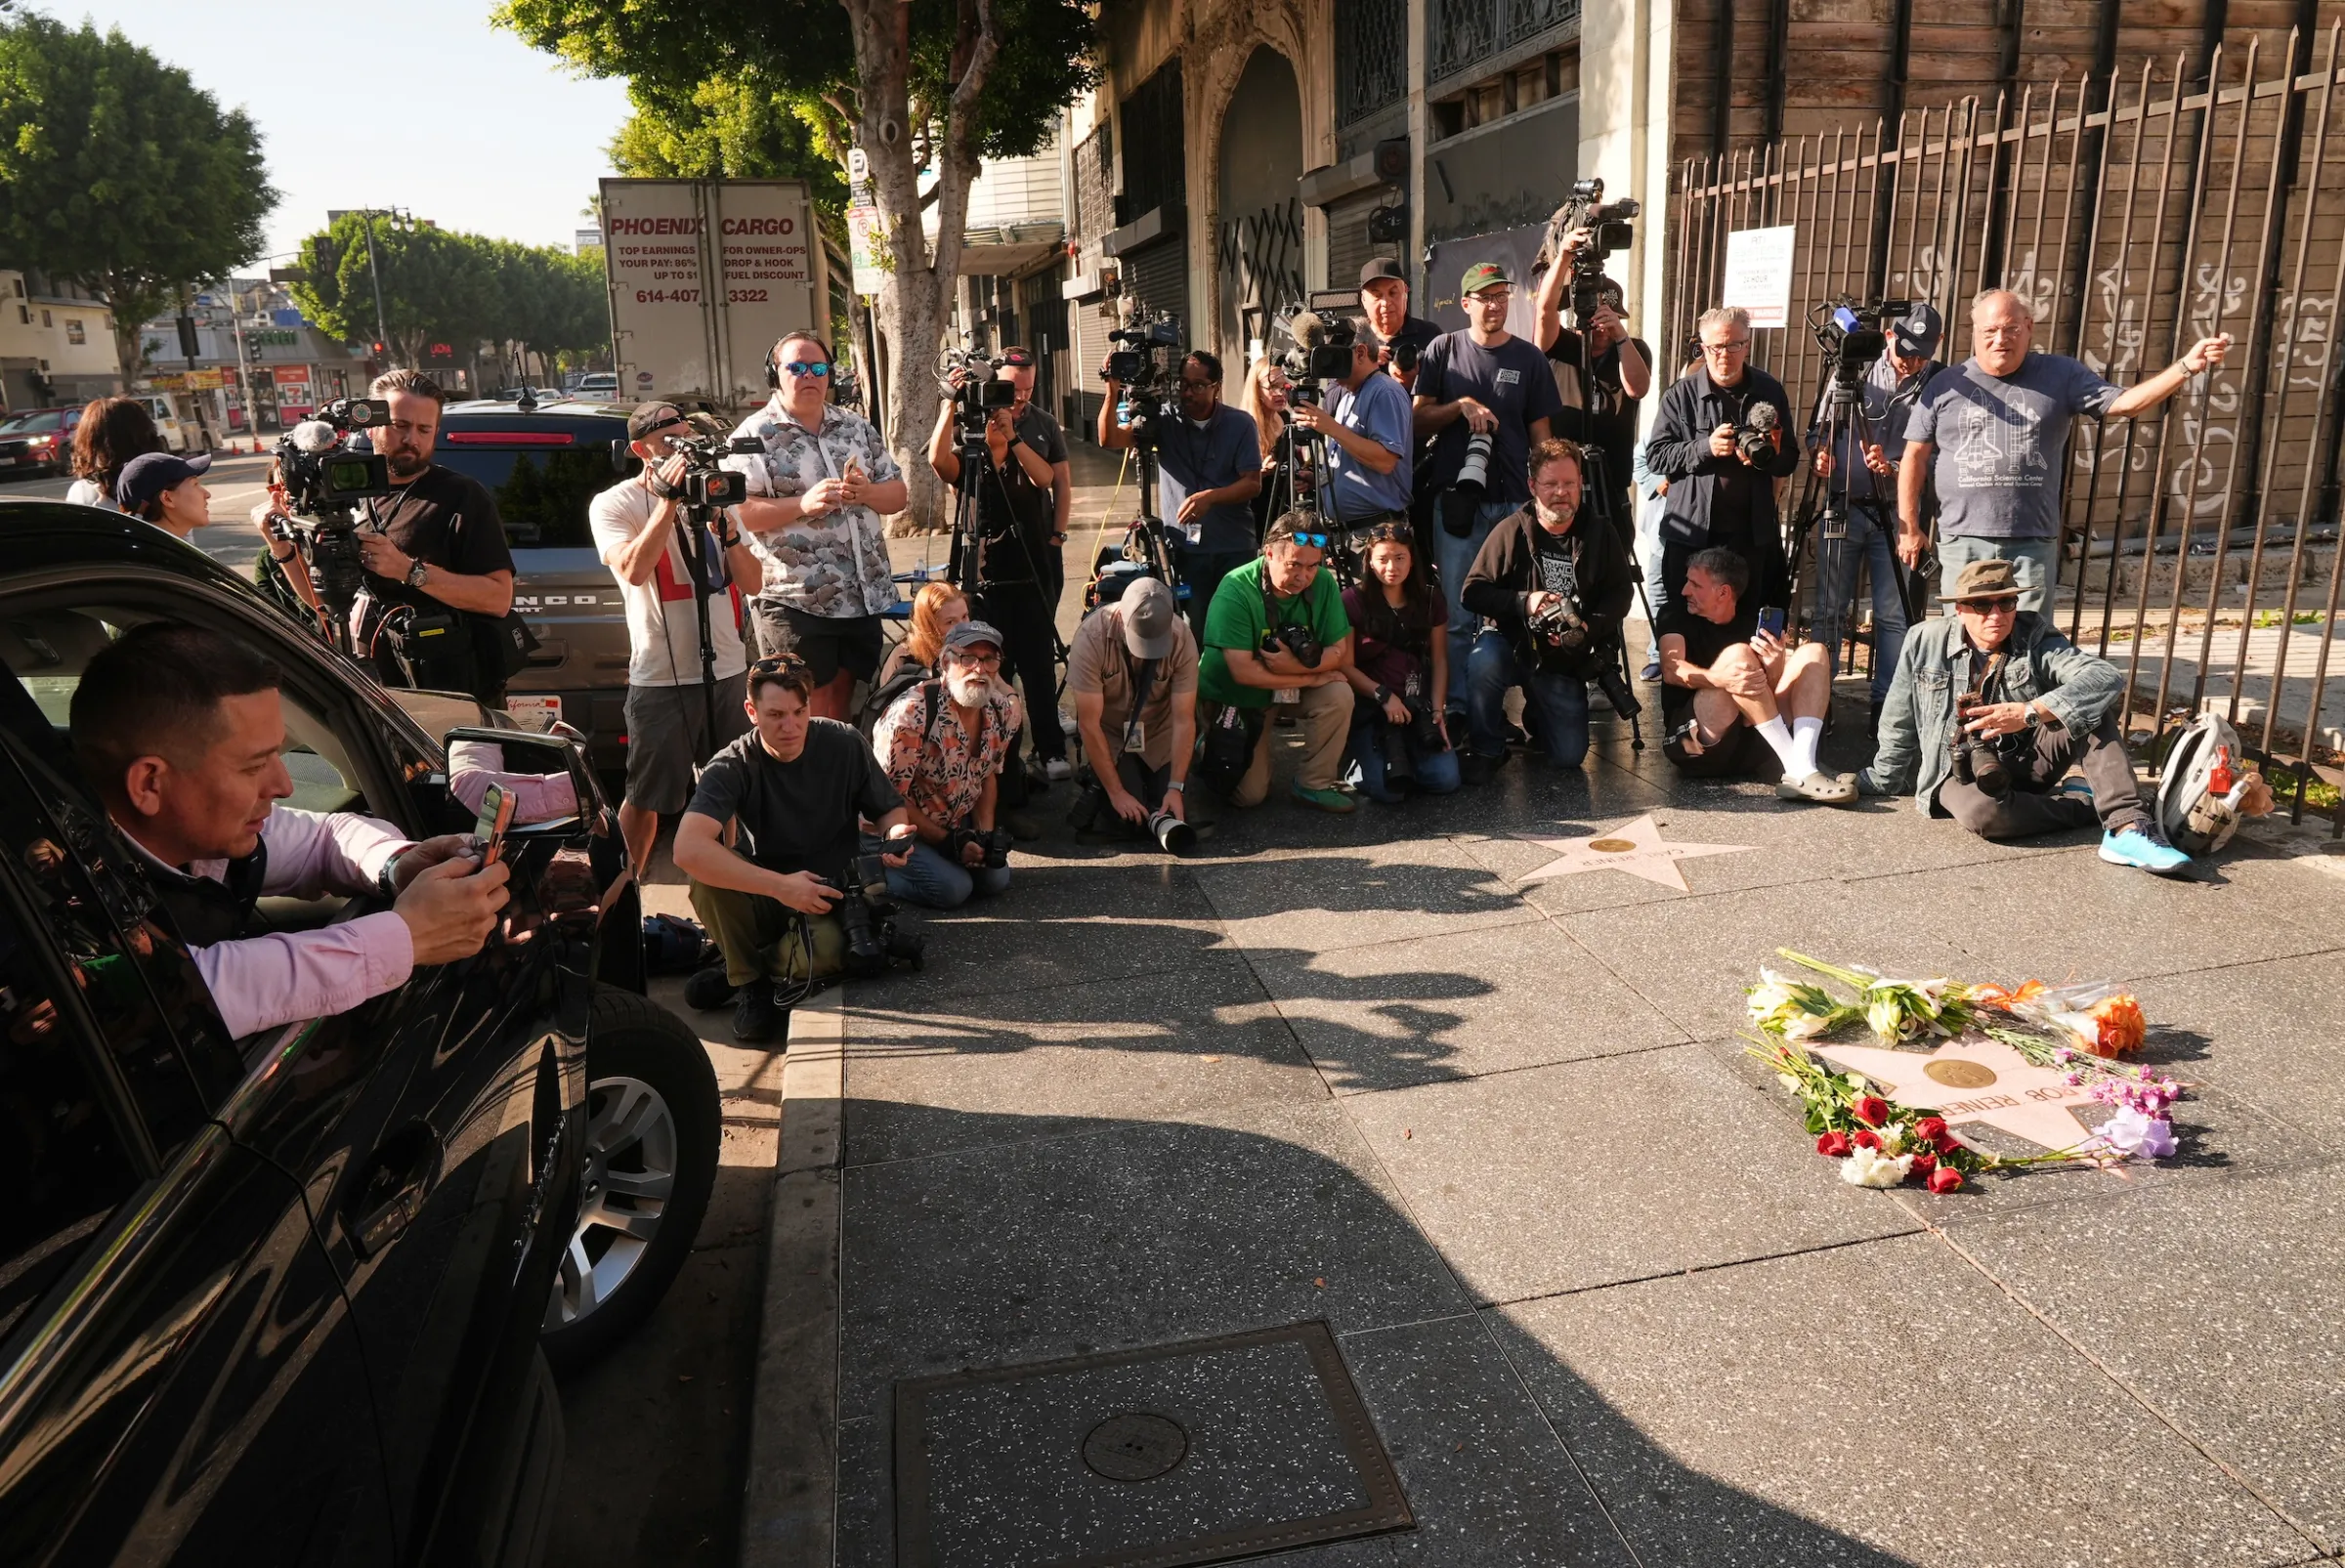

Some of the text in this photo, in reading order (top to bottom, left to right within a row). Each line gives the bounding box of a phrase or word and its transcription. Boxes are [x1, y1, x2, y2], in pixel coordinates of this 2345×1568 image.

[610, 218, 794, 235] PHOENIX CARGO
[618, 246, 807, 255] TOP EARNINGS FOR OWNER-OPS
[619, 259, 649, 268] YOUR
[651, 259, 673, 268] PAY:
[674, 259, 697, 268] 86%
[724, 259, 751, 268] DROP
[636, 289, 768, 304] 614-407 3322
[515, 596, 596, 606] NCO
[1933, 1085, 2079, 1117] ROB REINER
